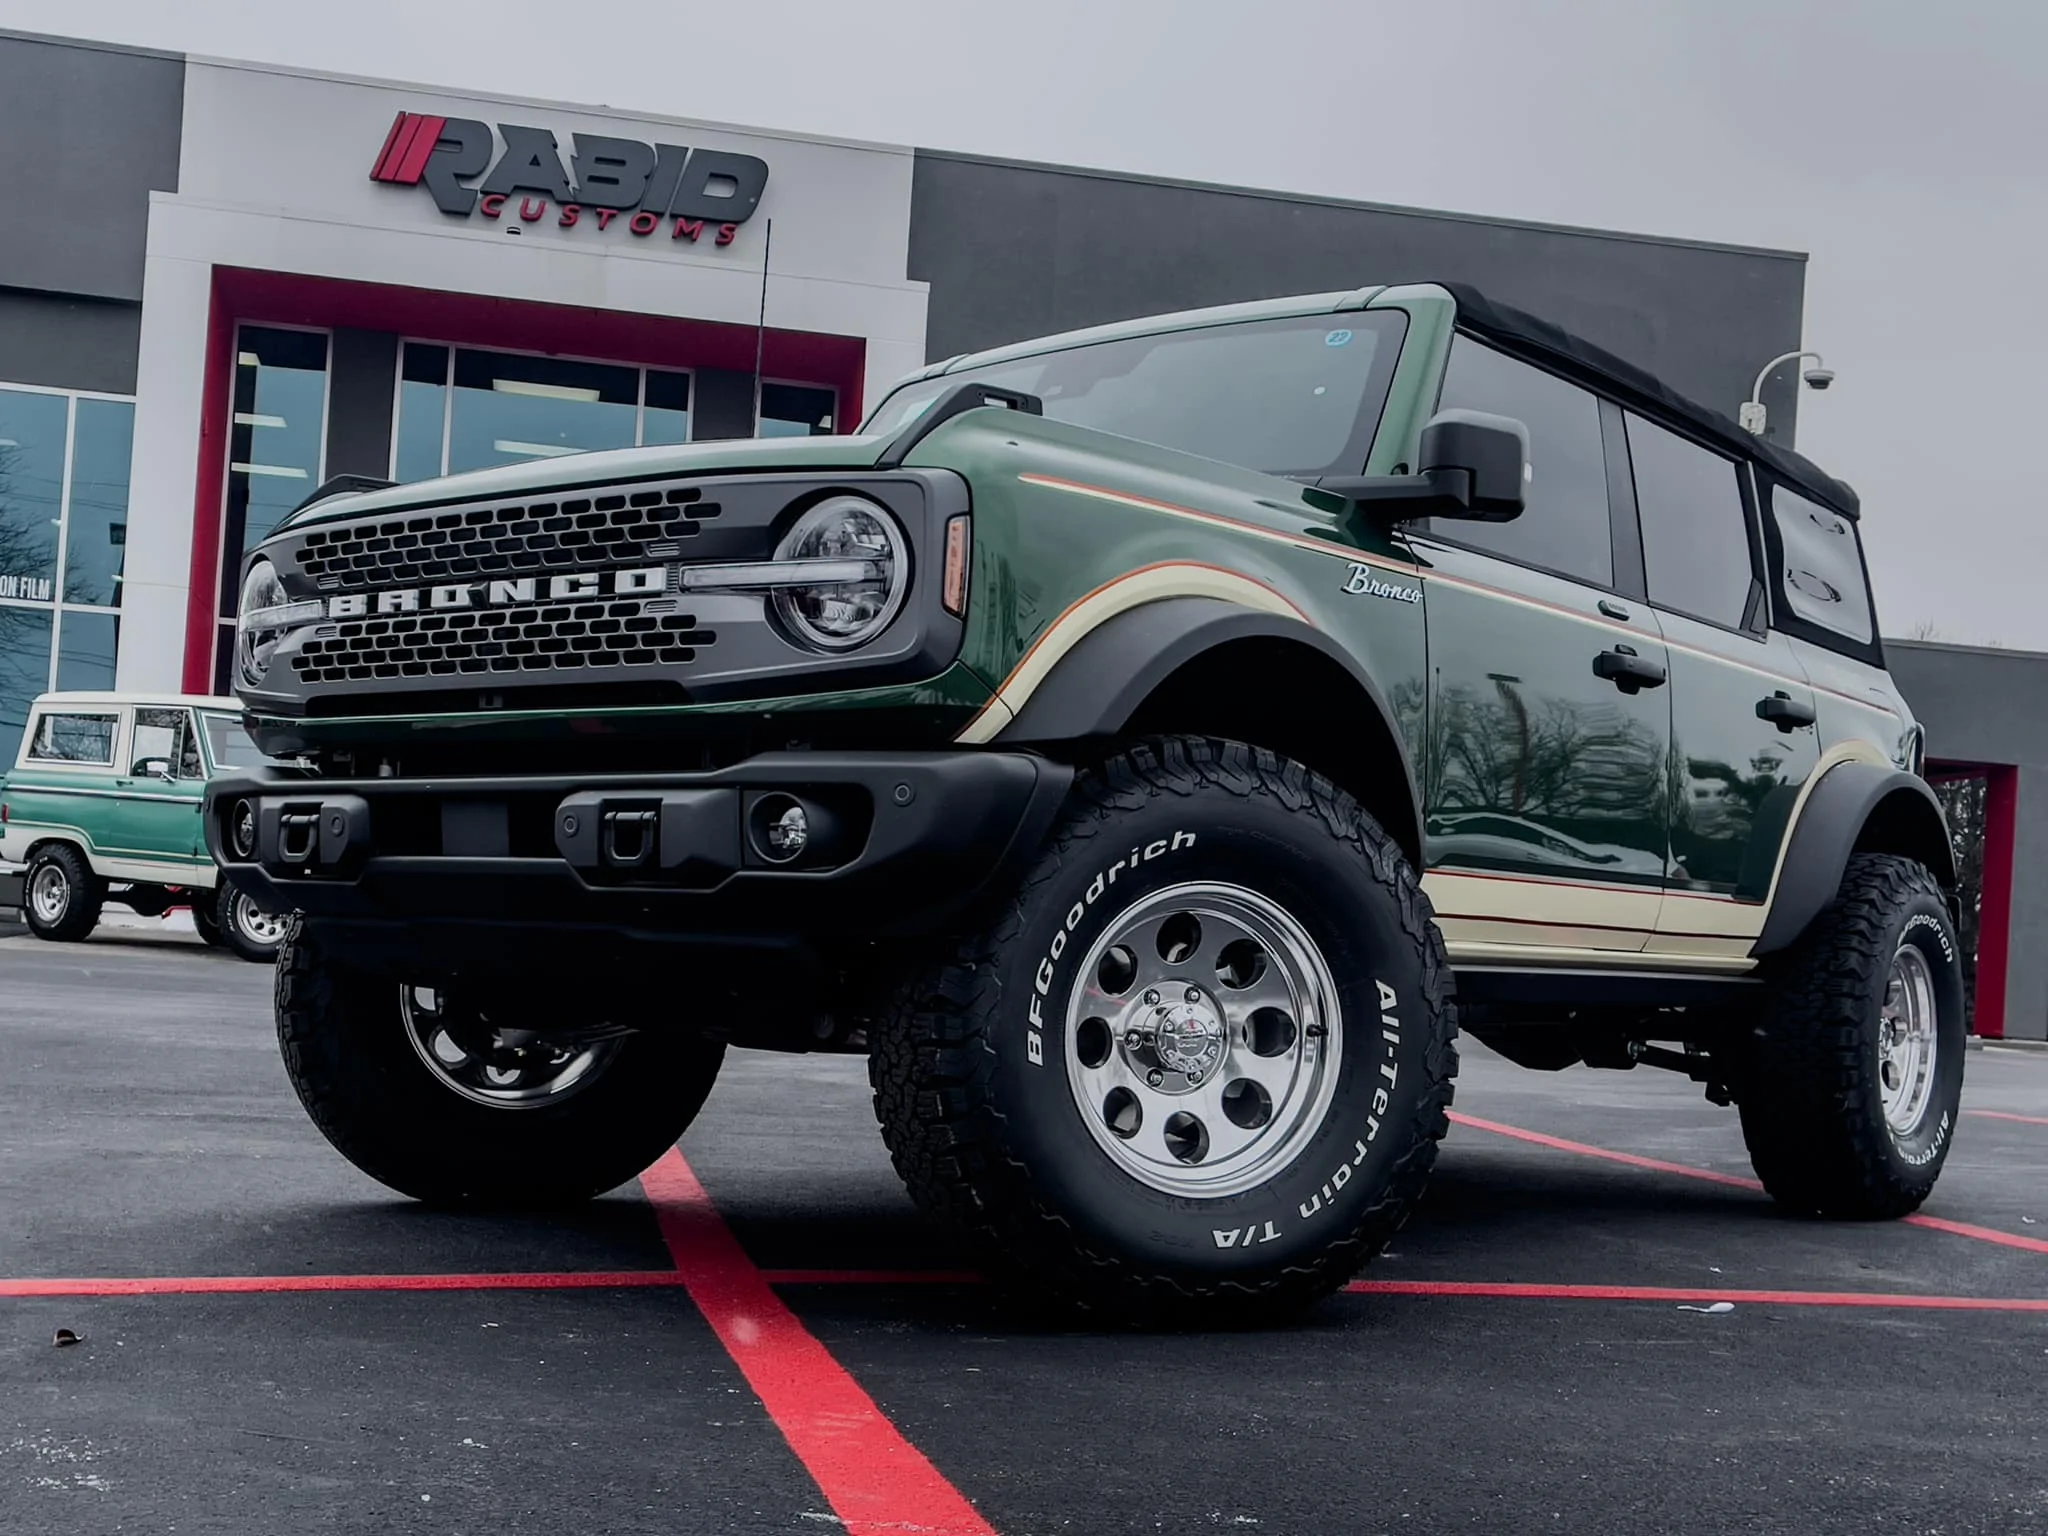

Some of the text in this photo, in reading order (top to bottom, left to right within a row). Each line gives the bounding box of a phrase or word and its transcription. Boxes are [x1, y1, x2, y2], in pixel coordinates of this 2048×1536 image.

[370, 111, 769, 223] RABID
[480, 194, 738, 245] CUSTOMS
[20, 577, 50, 600] FILM
[328, 566, 667, 620] BRONCO
[1342, 562, 1424, 604] Bronco
[1027, 830, 1197, 1067] BFGoodrich
[1212, 978, 1399, 1248] All-Terrain T/A
